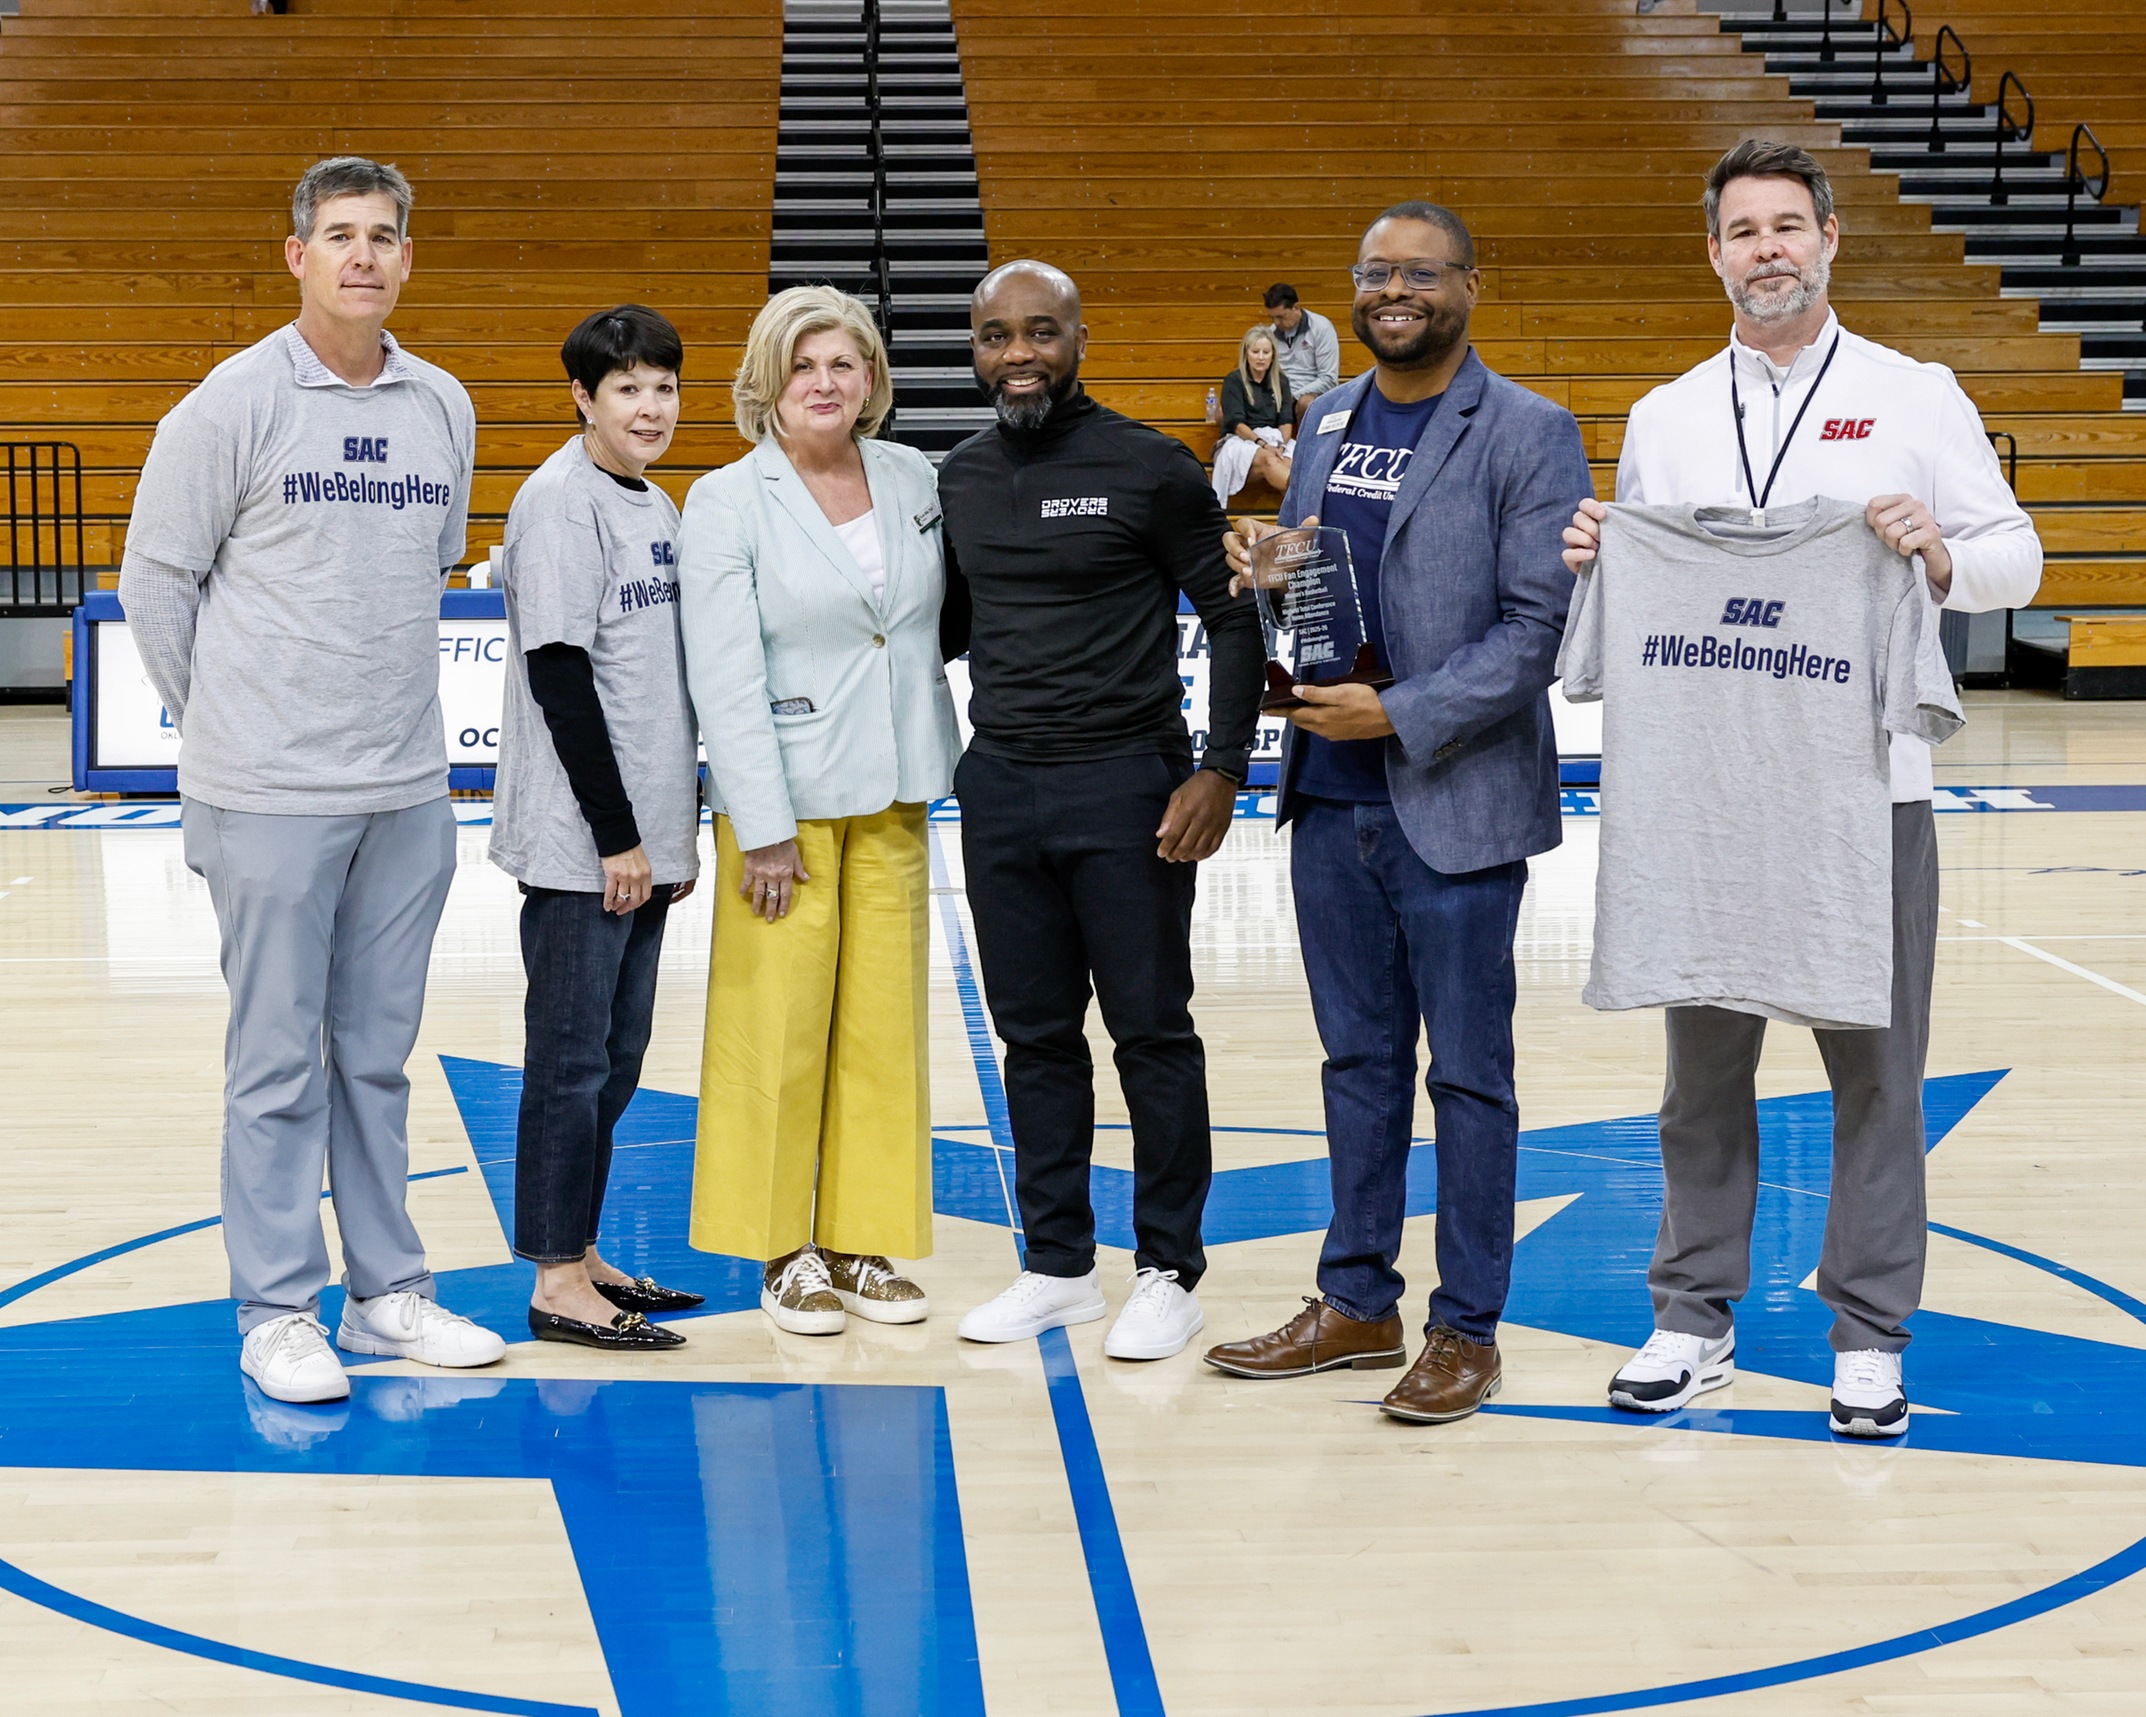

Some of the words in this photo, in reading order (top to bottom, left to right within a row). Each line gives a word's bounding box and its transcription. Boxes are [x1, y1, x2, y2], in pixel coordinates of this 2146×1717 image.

[1819, 418, 1877, 441] SAC
[343, 436, 389, 463] SAC
[283, 471, 450, 511] #WeBelongHere
[1357, 488, 1383, 500] Credit
[1041, 497, 1108, 509] DROVERS
[1275, 539, 1319, 557] TFCU
[1267, 572, 1284, 583] TFCU
[1284, 570, 1297, 580] Fan
[1297, 563, 1338, 578] Engagement
[1287, 576, 1321, 590] Champion
[1719, 597, 1786, 628] SAC
[1301, 641, 1335, 663] SAC
[1642, 635, 1851, 684] #WeBelongHere
